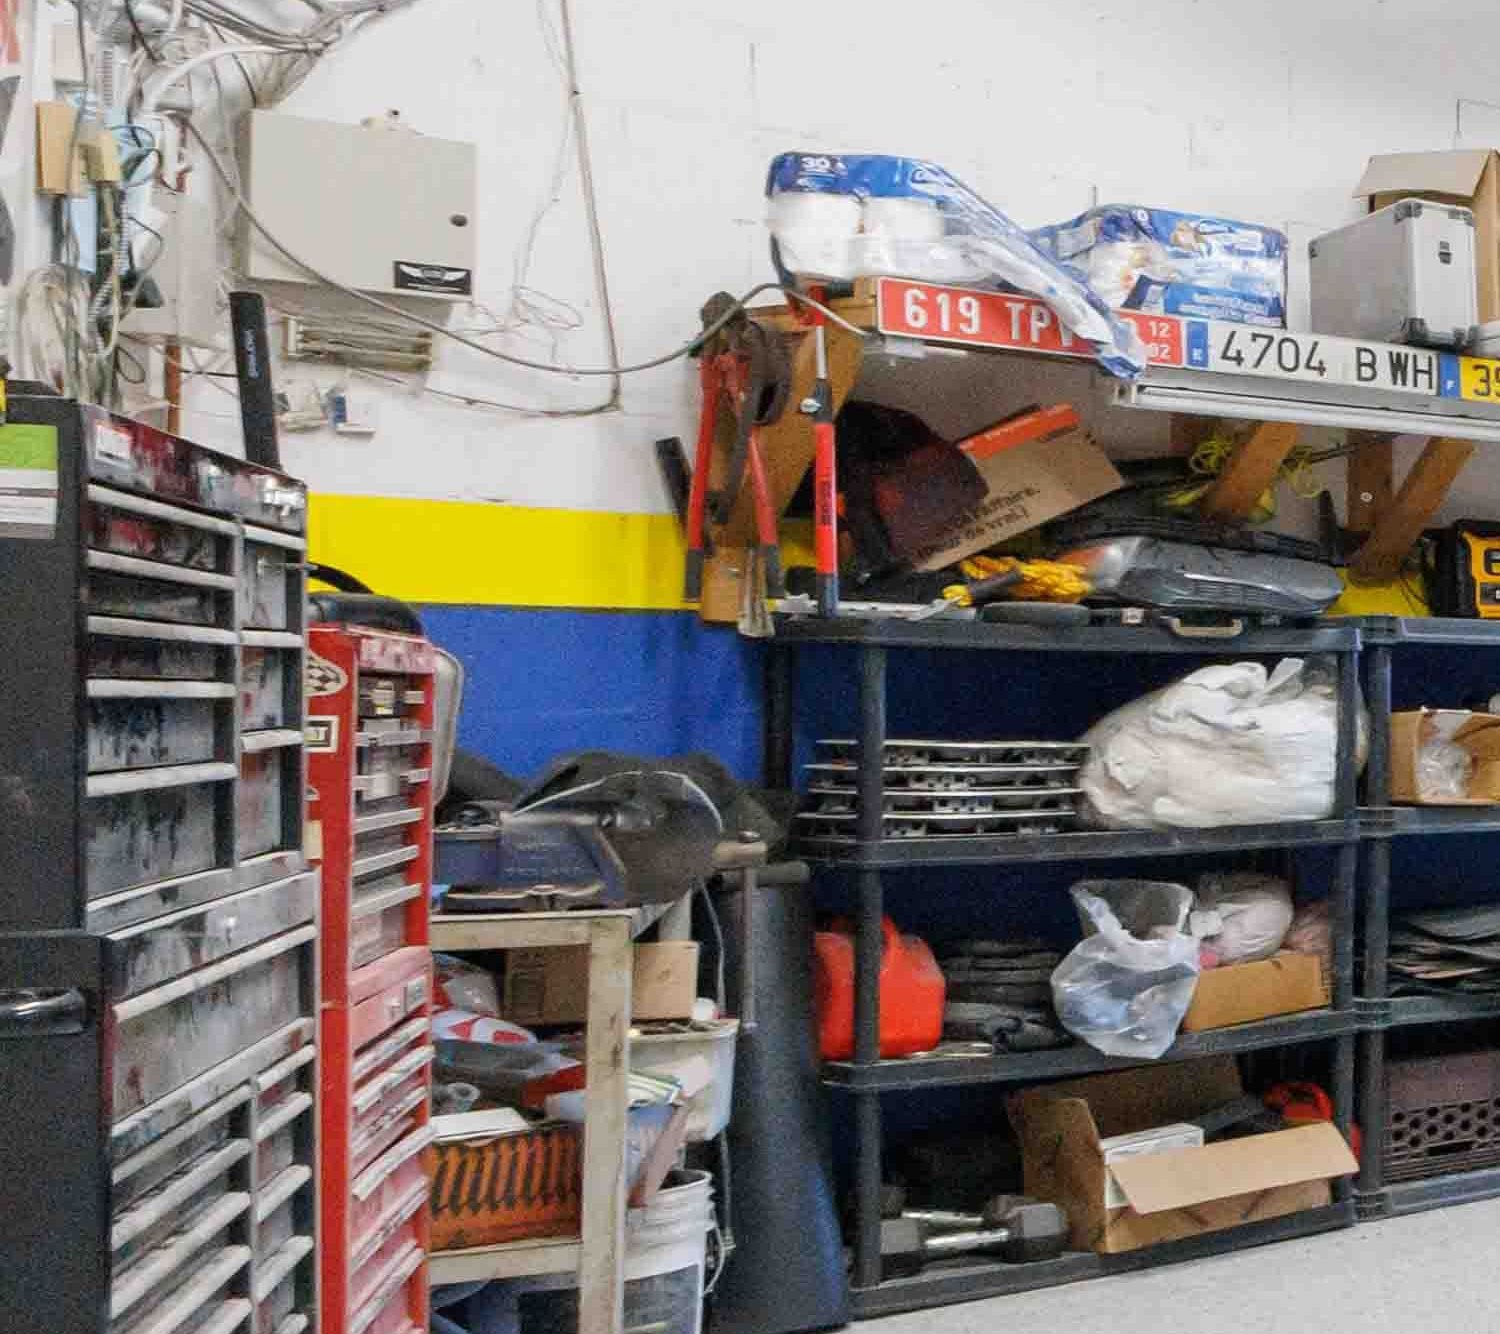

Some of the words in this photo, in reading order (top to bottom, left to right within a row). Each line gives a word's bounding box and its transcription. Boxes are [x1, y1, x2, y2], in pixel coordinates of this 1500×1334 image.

[904, 288, 981, 335] 619
[1150, 322, 1170, 336] 12
[1220, 330, 1327, 377] 4704
